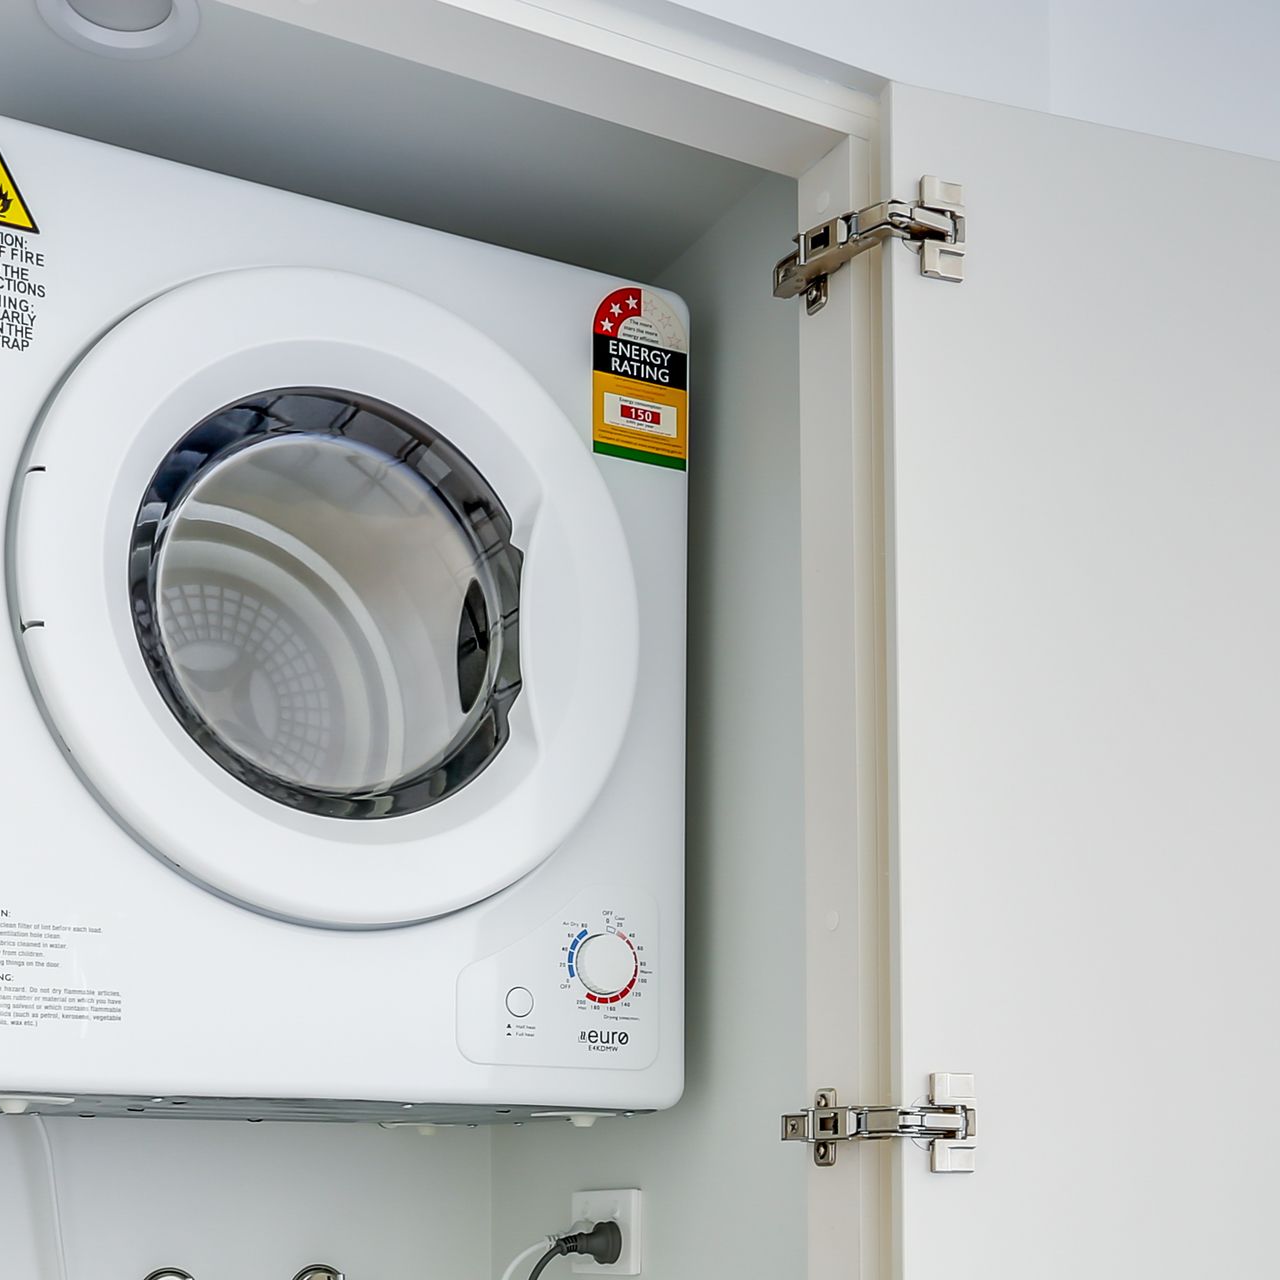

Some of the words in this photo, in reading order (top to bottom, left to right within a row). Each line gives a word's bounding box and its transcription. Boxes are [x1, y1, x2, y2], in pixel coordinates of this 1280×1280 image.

[11, 248, 44, 267] FIRE
[2, 263, 29, 281] THE
[6, 323, 33, 340] THE
[609, 340, 672, 366] ENERGY
[611, 357, 670, 383] RATING
[630, 408, 652, 422] 150
[5, 959, 25, 967] things
